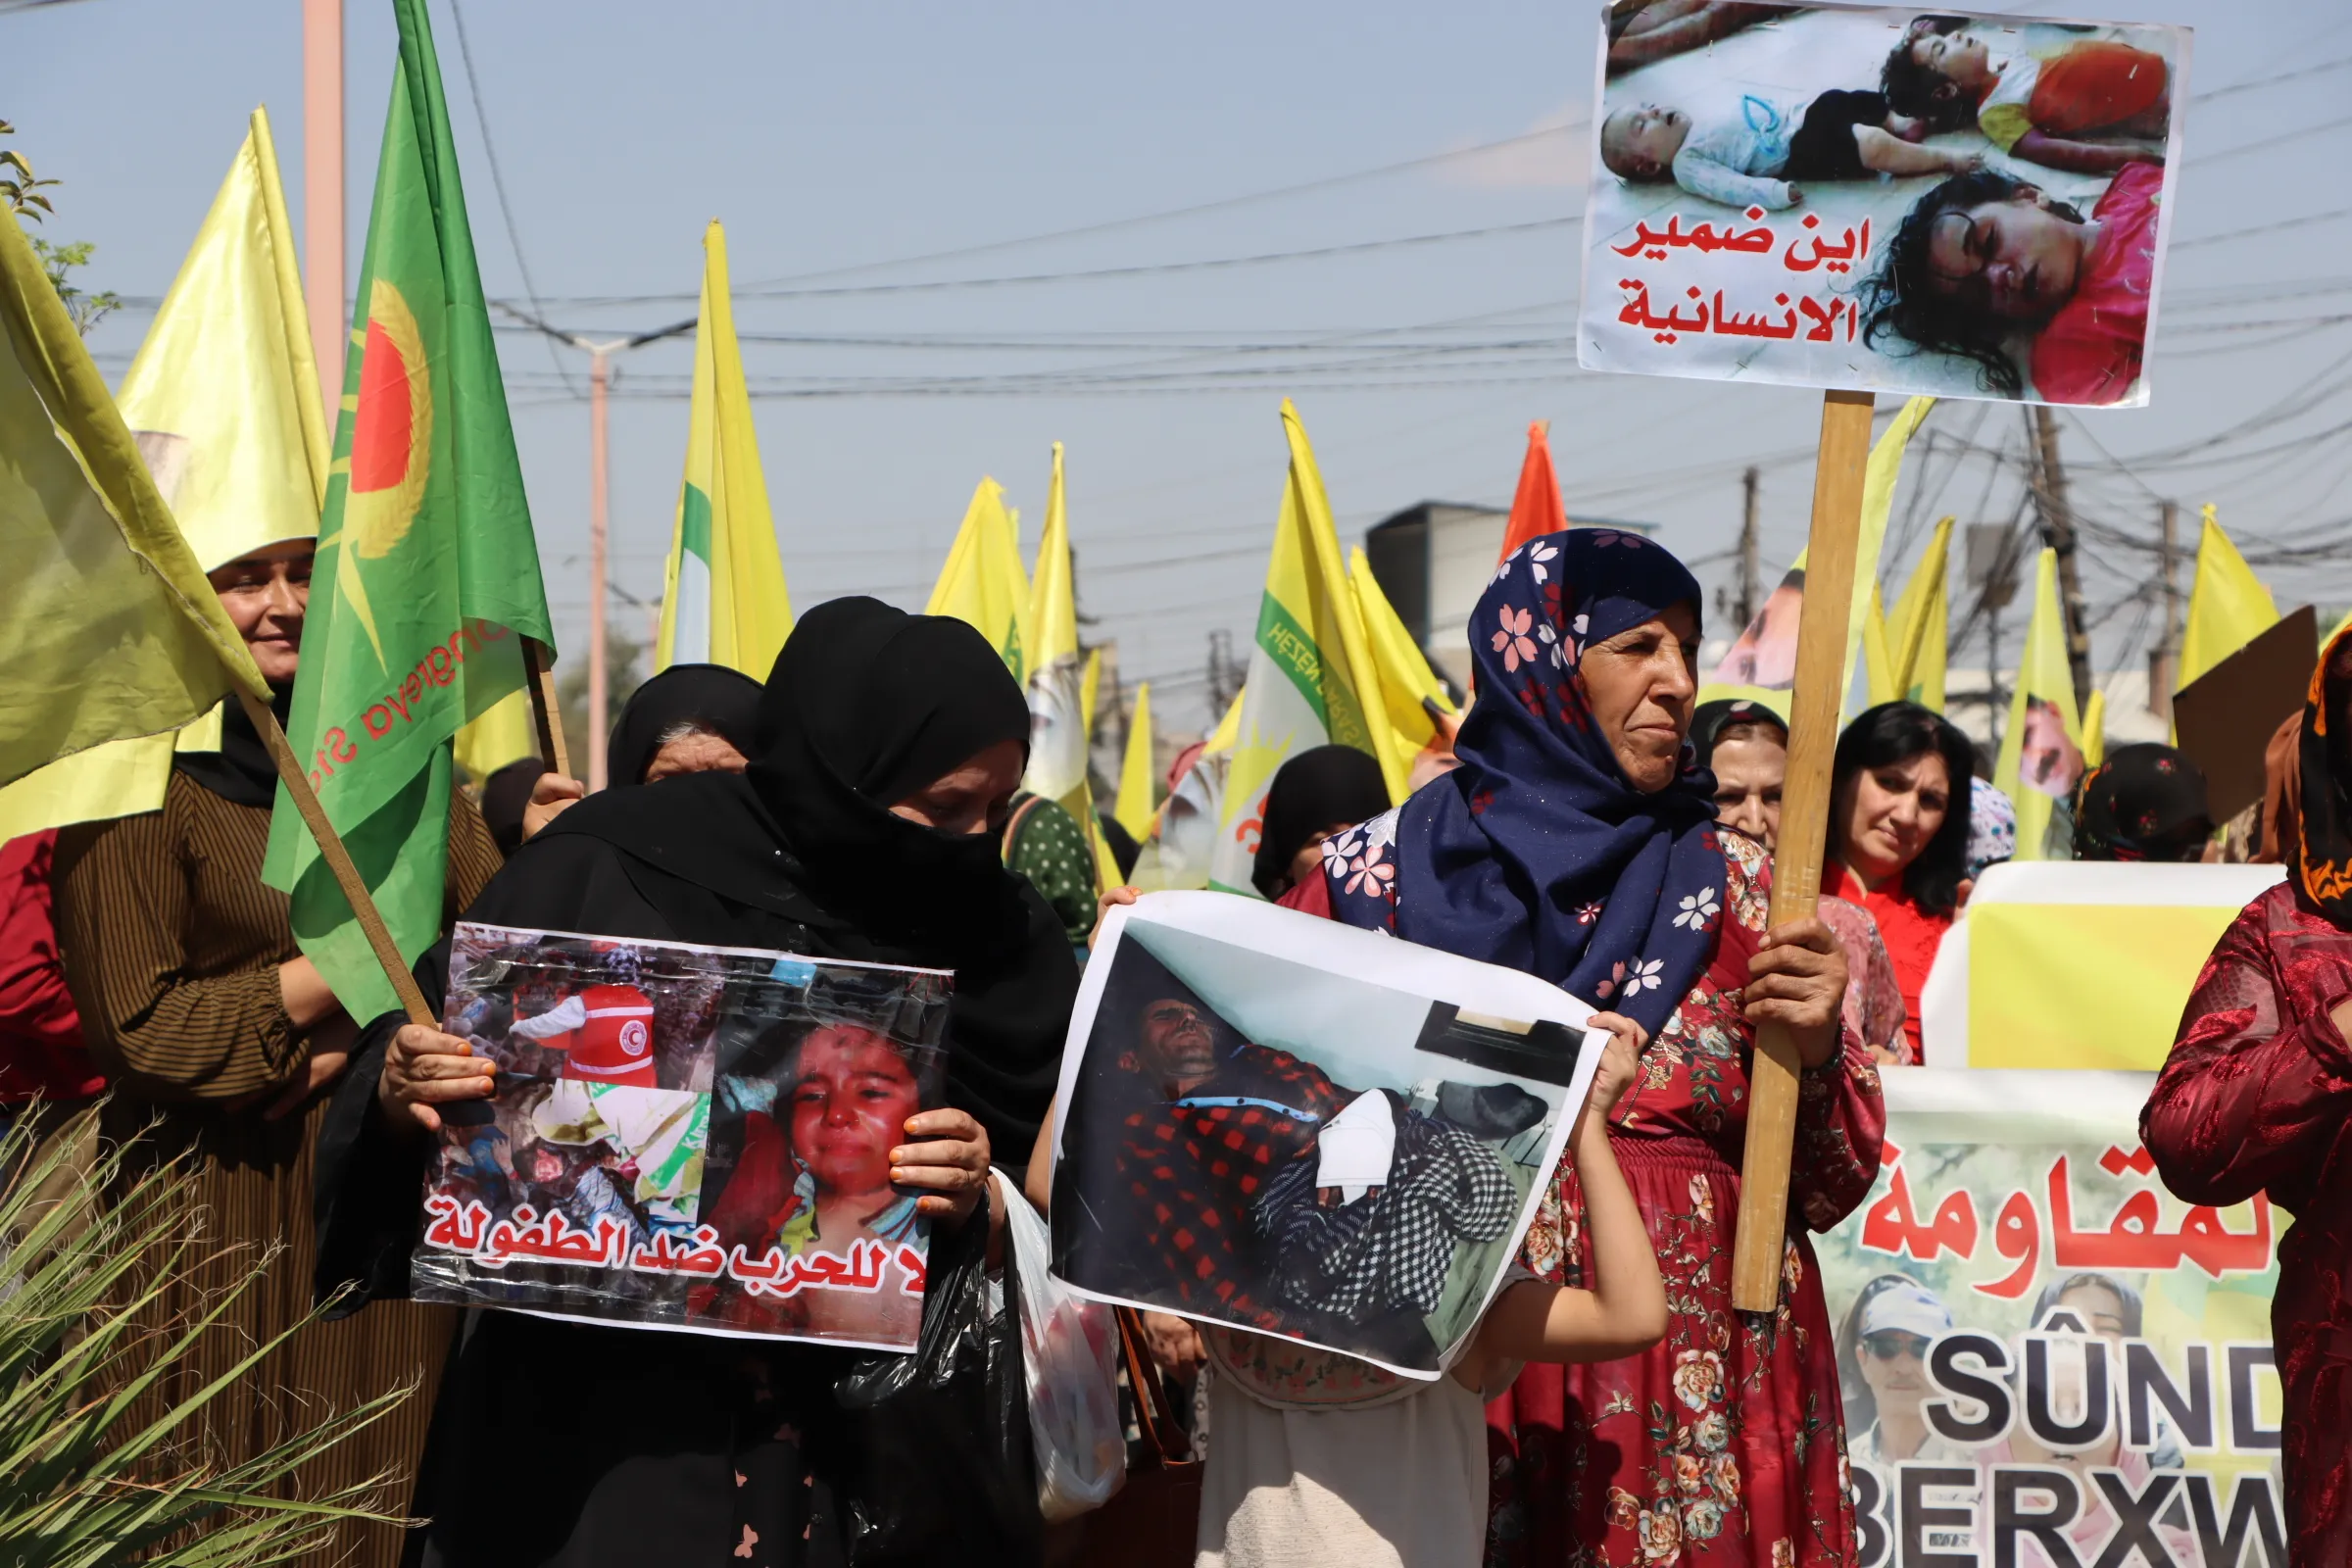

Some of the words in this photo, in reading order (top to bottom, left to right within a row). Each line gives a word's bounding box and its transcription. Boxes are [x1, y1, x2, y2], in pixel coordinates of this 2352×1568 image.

[1610, 206, 1775, 262] ضمير
[1784, 213, 1870, 274] اين
[1618, 277, 1858, 345] الانسانية
[429, 1199, 627, 1265] الطفولة
[633, 1228, 724, 1274] ضد
[731, 1242, 887, 1294] للحرب
